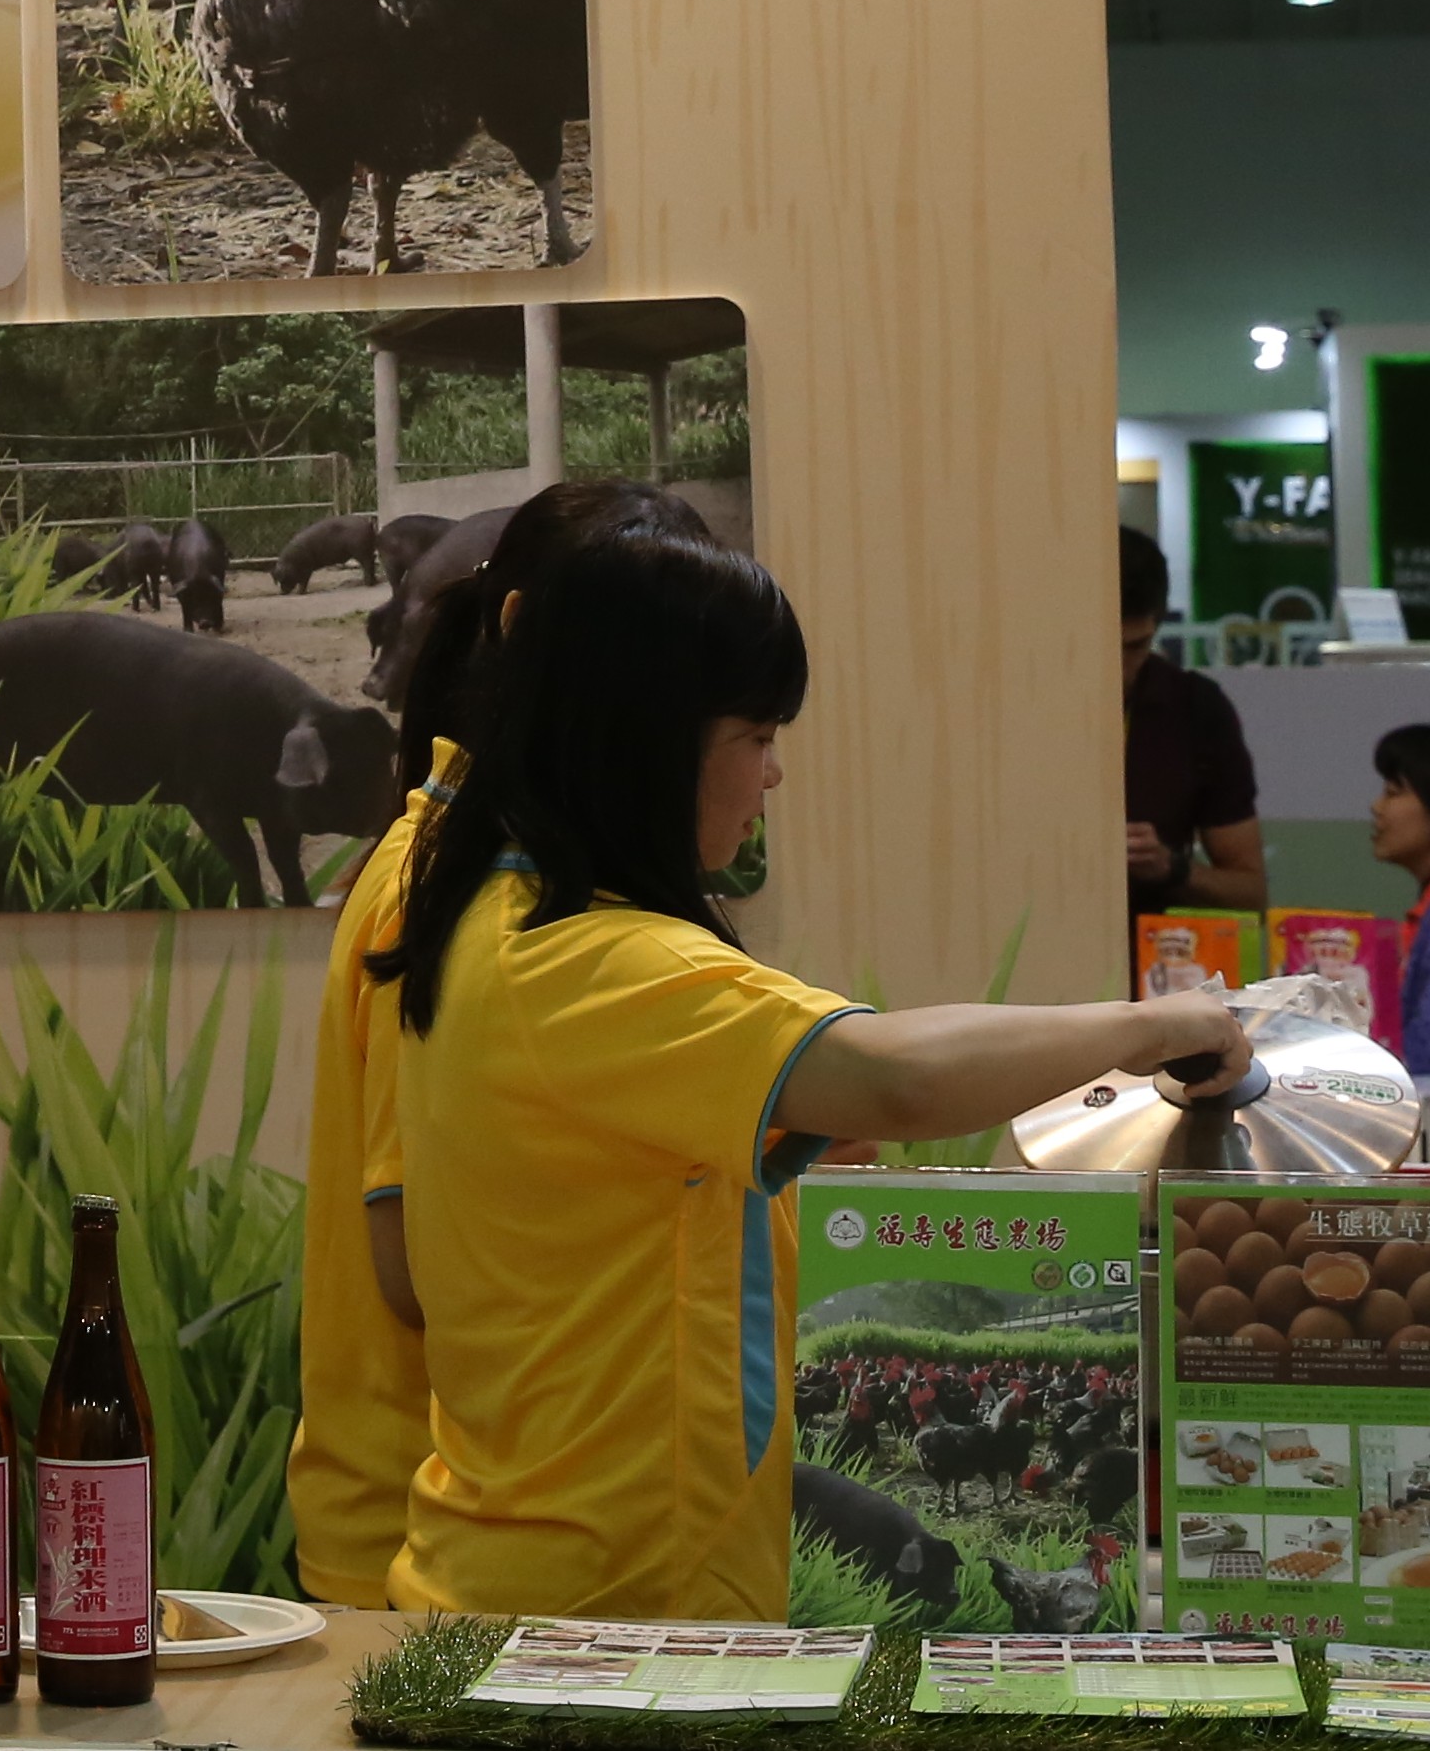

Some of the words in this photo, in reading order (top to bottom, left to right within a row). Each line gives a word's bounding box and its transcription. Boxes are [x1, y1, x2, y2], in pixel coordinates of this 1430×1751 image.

[874, 1212, 1068, 1252] 福壽生態農場
[71, 1480, 107, 1613] 紅標料理米酒
